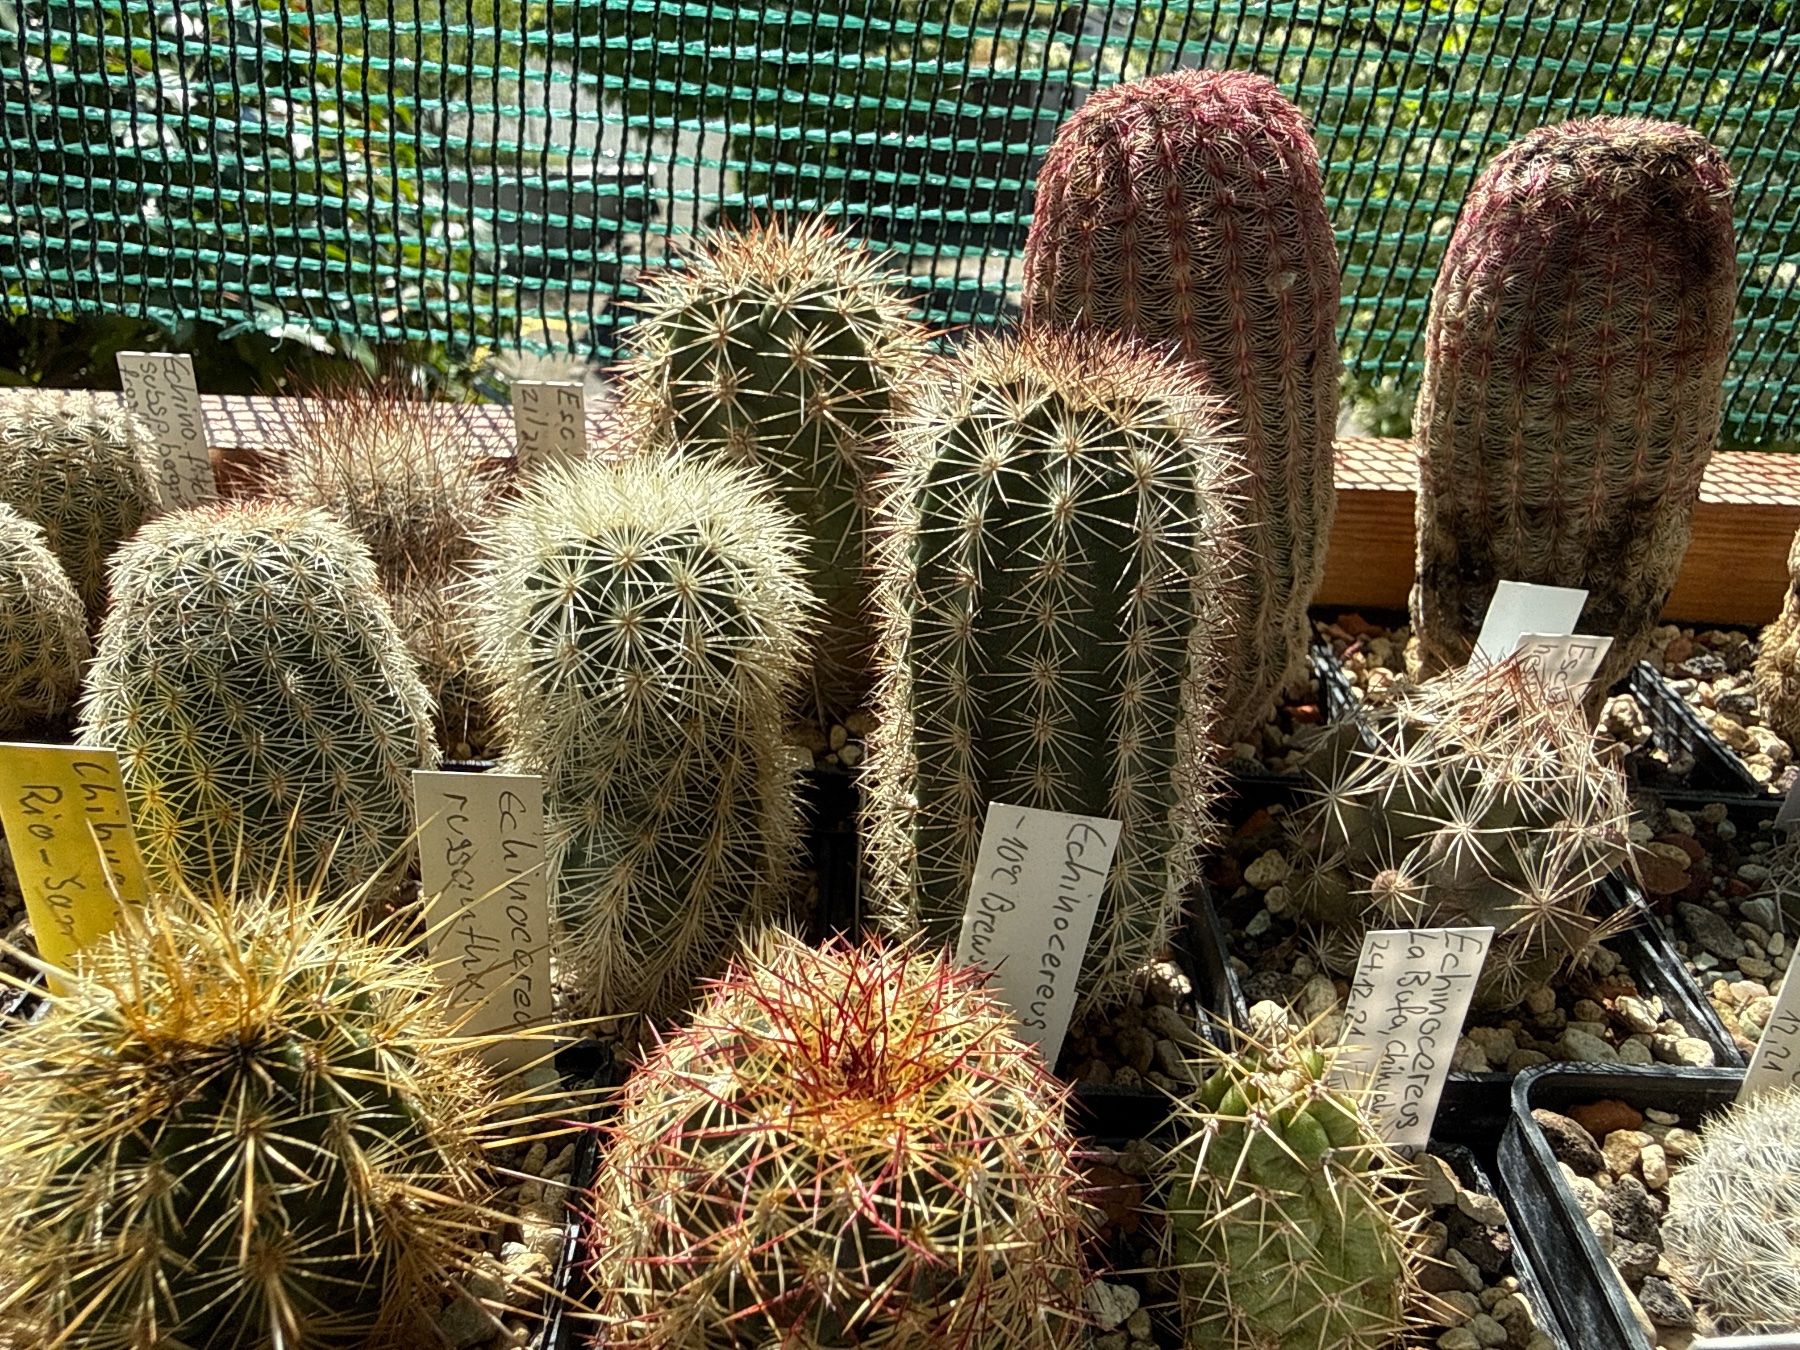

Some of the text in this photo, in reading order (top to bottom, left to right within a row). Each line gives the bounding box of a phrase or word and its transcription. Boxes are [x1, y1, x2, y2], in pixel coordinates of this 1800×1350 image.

[498, 789, 542, 1034] Echinocereu
[1021, 822, 1108, 1031] Echinocereus
[1405, 931, 1438, 960] La
[1395, 930, 1484, 1131] Echinocereus
